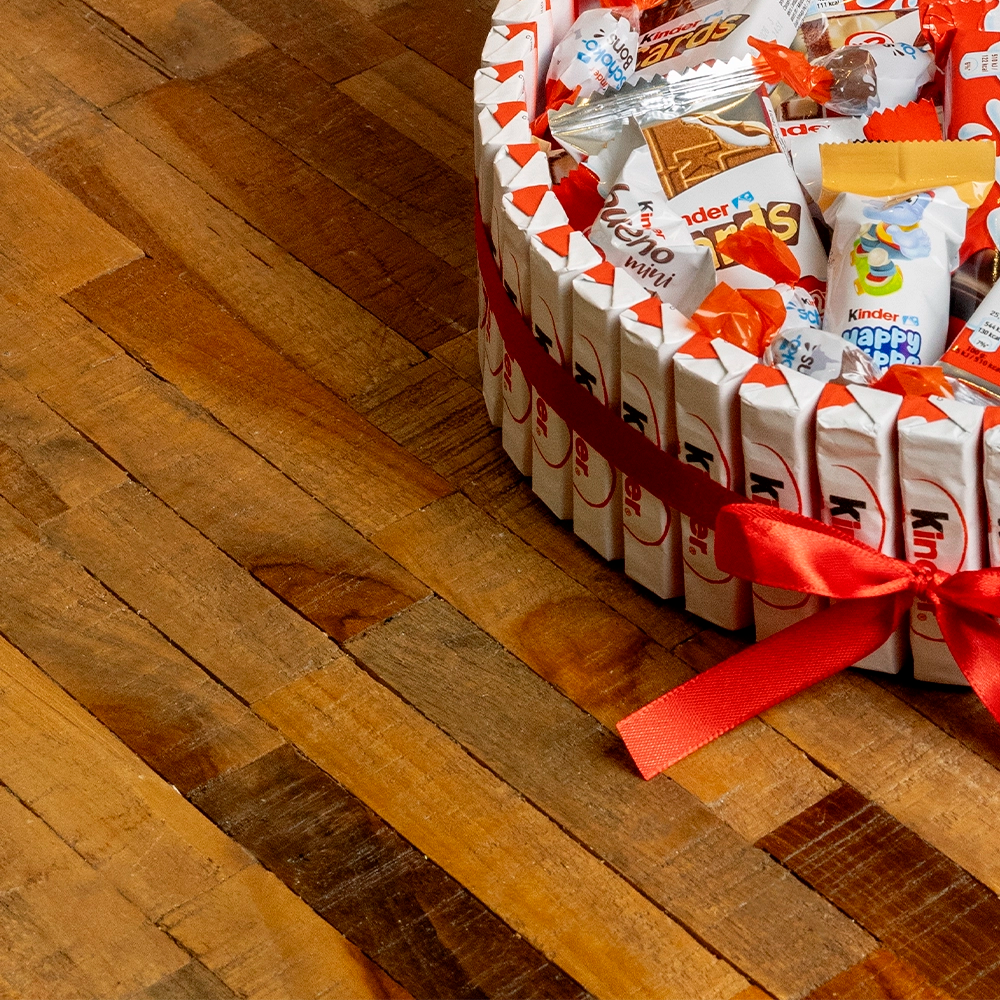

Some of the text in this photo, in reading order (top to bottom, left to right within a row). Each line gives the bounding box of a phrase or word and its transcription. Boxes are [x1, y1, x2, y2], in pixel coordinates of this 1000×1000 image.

[641, 20, 702, 44] Kinder
[624, 256, 676, 289] mini
[848, 308, 899, 323] Kinder
